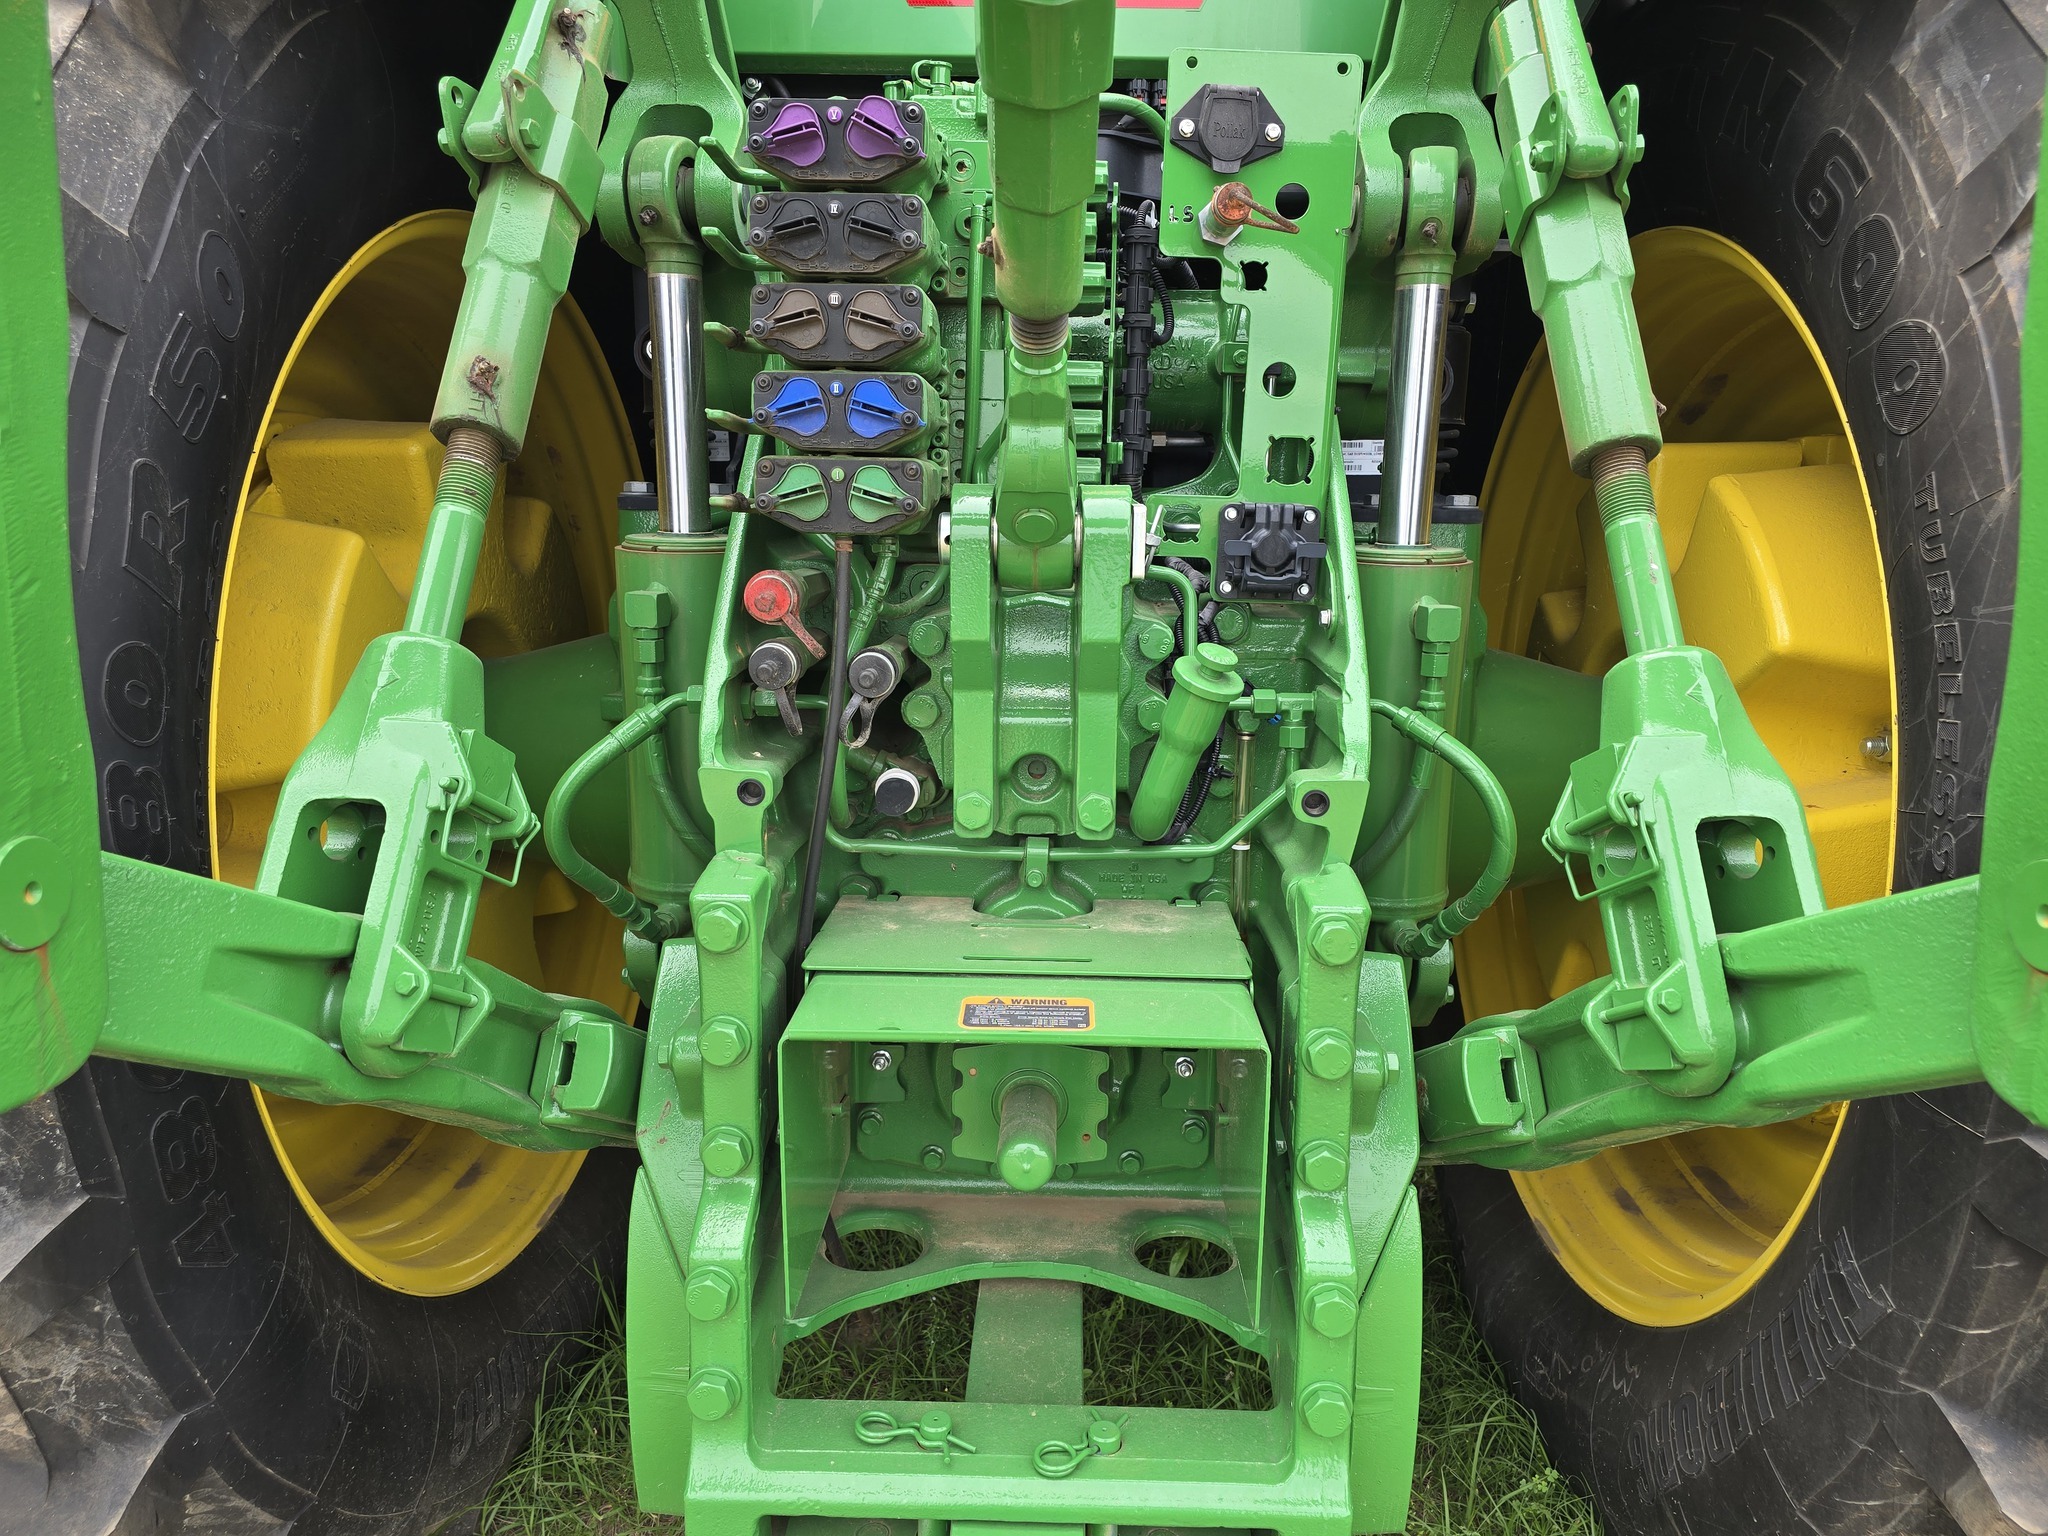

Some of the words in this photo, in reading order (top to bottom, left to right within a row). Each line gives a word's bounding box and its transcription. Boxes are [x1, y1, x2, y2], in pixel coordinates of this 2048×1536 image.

[1213, 120, 1246, 140] Pollak
[1169, 205, 1194, 222] LS
[1793, 127, 1949, 435] 600
[1913, 471, 1965, 879] TUBELESS
[1098, 872, 1125, 882] MADE
[1148, 873, 1168, 883] USA
[1011, 998, 1068, 1006] WARNING
[1627, 1225, 1896, 1506] TRELLEBORG
